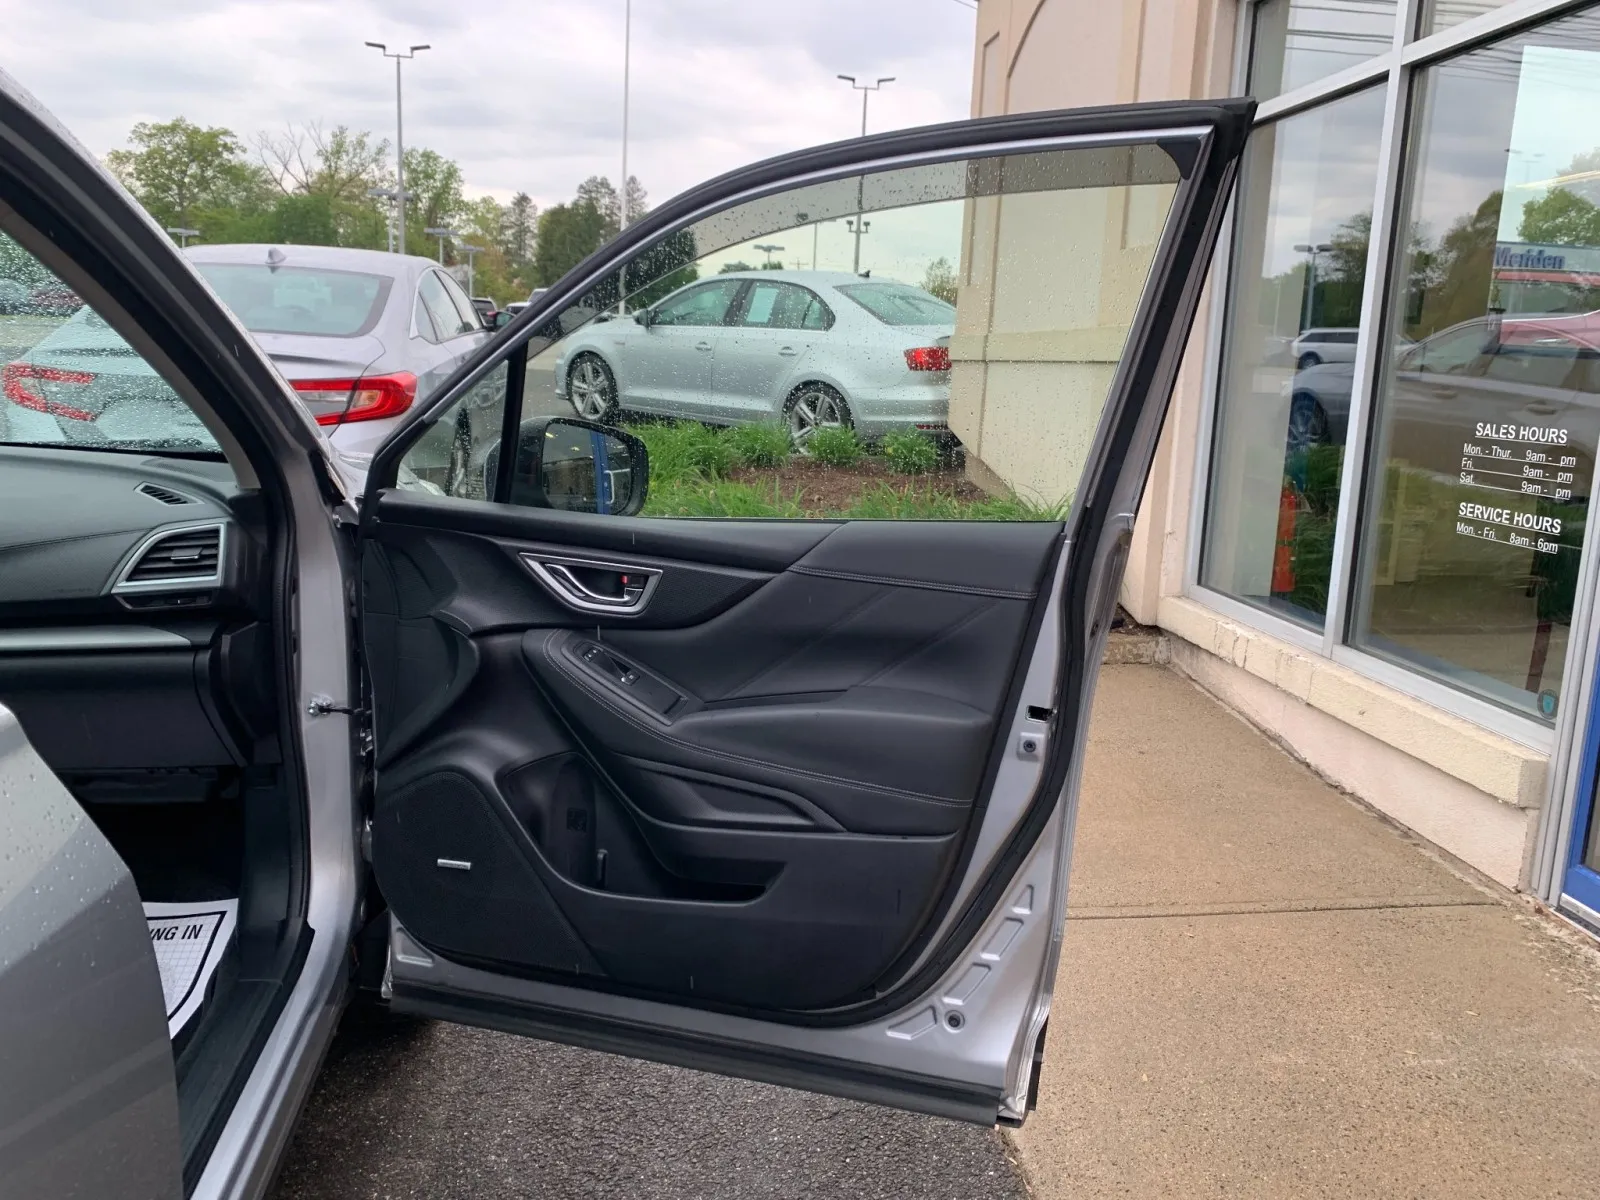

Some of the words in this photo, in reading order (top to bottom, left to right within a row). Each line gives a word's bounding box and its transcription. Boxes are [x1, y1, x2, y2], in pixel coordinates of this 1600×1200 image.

[1496, 247, 1565, 269] Meriden
[1475, 422, 1516, 439] SALES
[1519, 426, 1568, 444] HOURS
[1463, 443, 1483, 455] Mon.
[1491, 445, 1512, 459] Thur.
[1526, 449, 1546, 462] 9am
[1560, 455, 1576, 466] pm
[1461, 457, 1474, 469] Fri.
[1523, 465, 1543, 478] 9am
[1557, 472, 1573, 483] pm
[1459, 472, 1475, 484] Sat.
[1521, 481, 1541, 493] 9am
[1555, 488, 1571, 498] pm
[1458, 502, 1511, 524] SERVICE
[1513, 512, 1562, 533] HOURS
[1456, 521, 1476, 535] Mon.
[1483, 527, 1497, 540] Fri.
[1509, 532, 1529, 546] 8am
[1537, 538, 1559, 553] 6pm
[181, 924, 203, 940] IN
